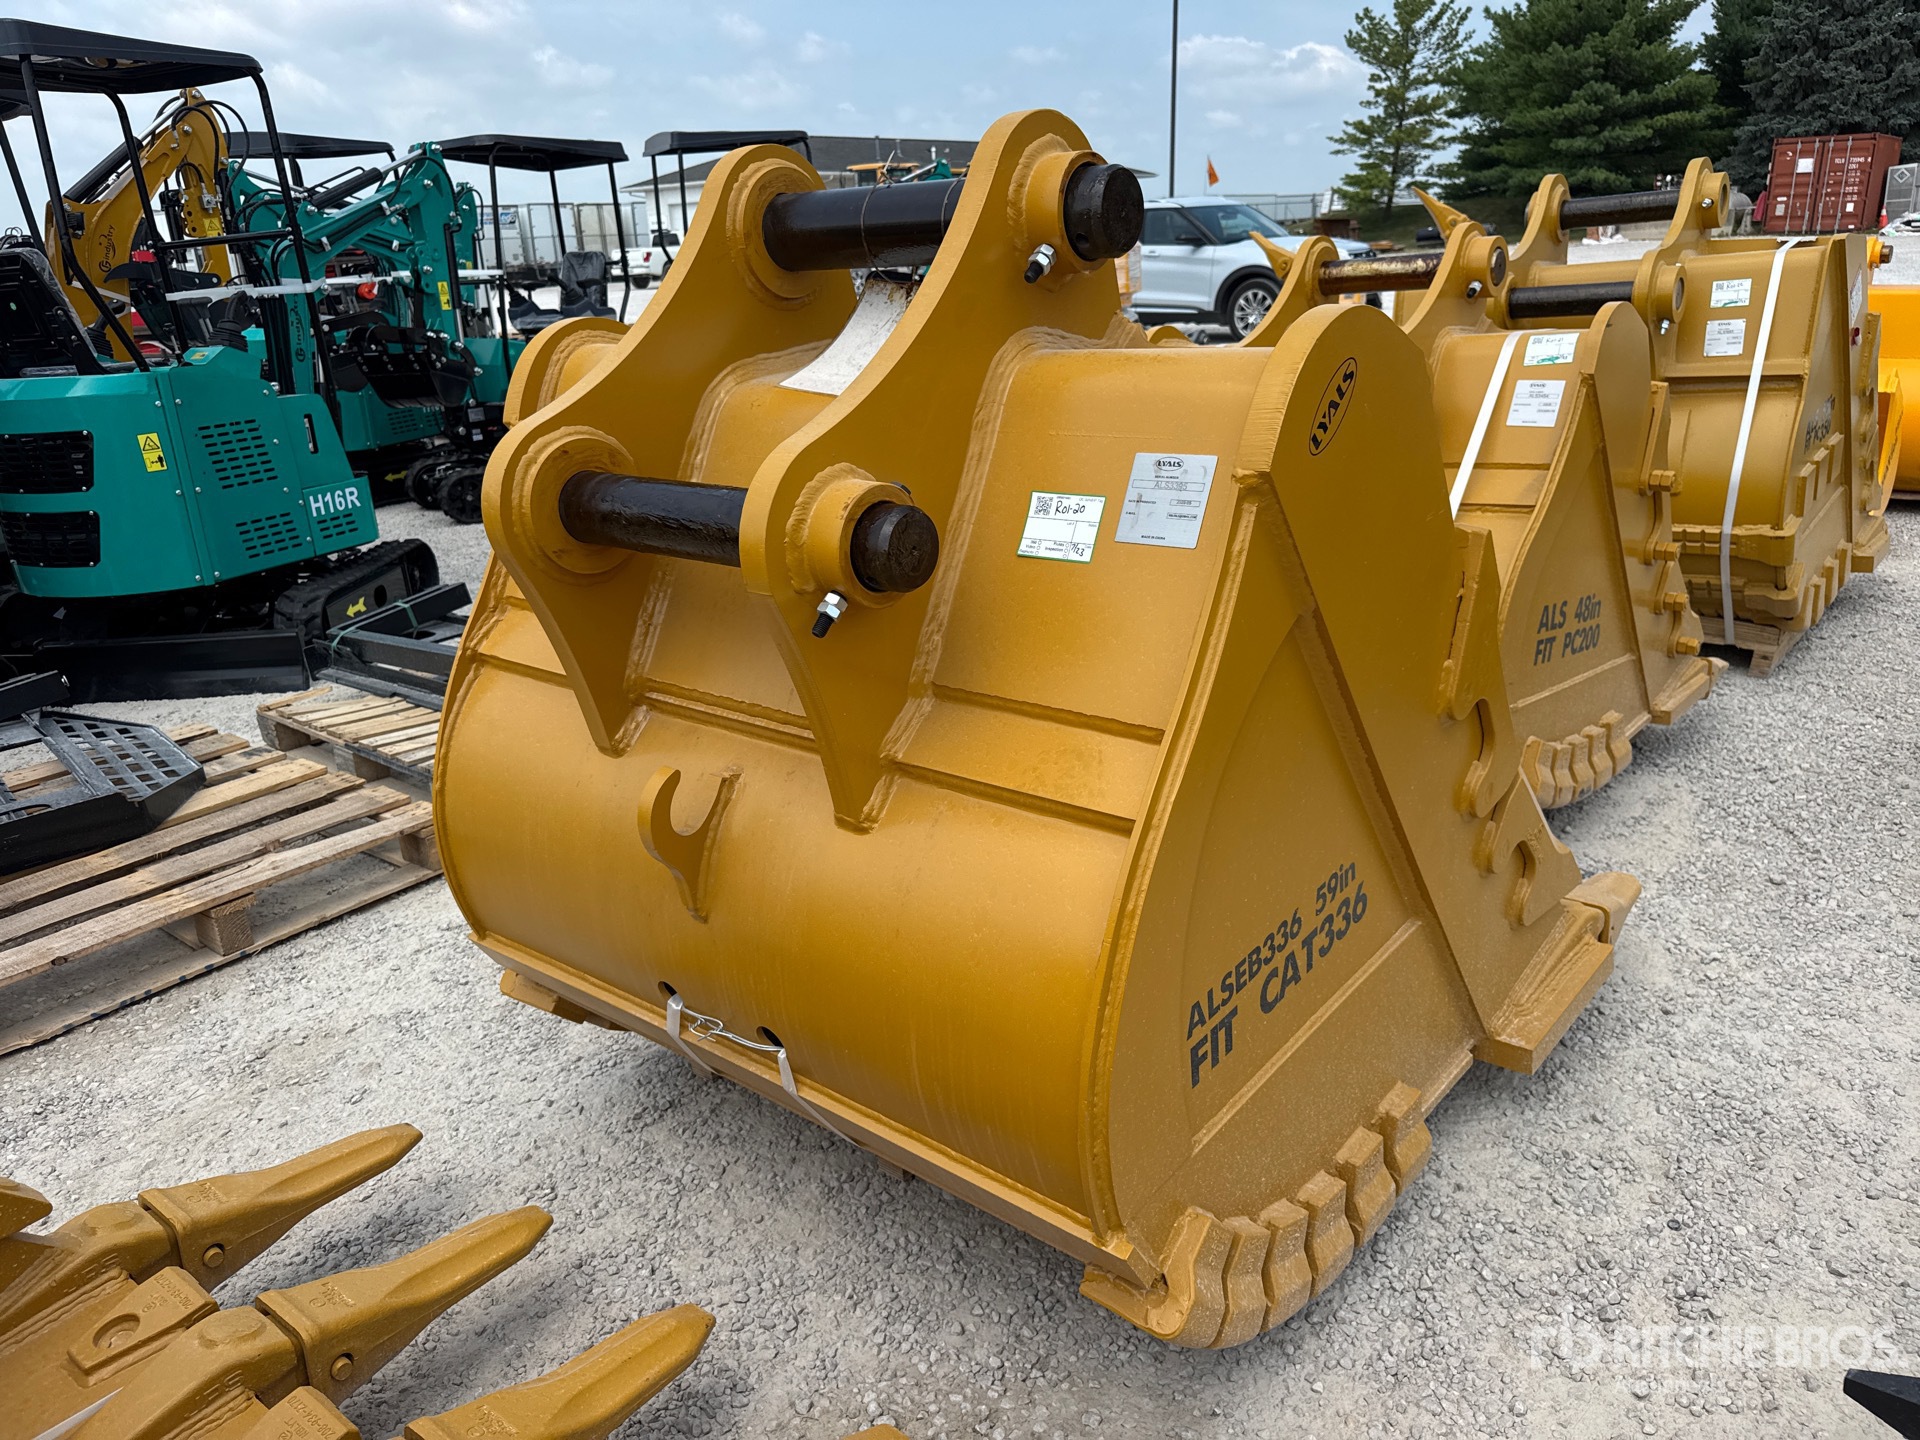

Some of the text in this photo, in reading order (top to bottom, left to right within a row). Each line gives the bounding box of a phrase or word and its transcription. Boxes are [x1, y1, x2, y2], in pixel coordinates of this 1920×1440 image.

[1311, 362, 1355, 450] LYALS
[1156, 460, 1183, 468] LYALS
[309, 487, 362, 518] H16R
[1537, 593, 1601, 634] ALS 48in
[1533, 623, 1600, 666] FIT PC200
[1186, 862, 1356, 1041] ALSEB336 59in
[1190, 880, 1368, 1089] FIT CAT336
